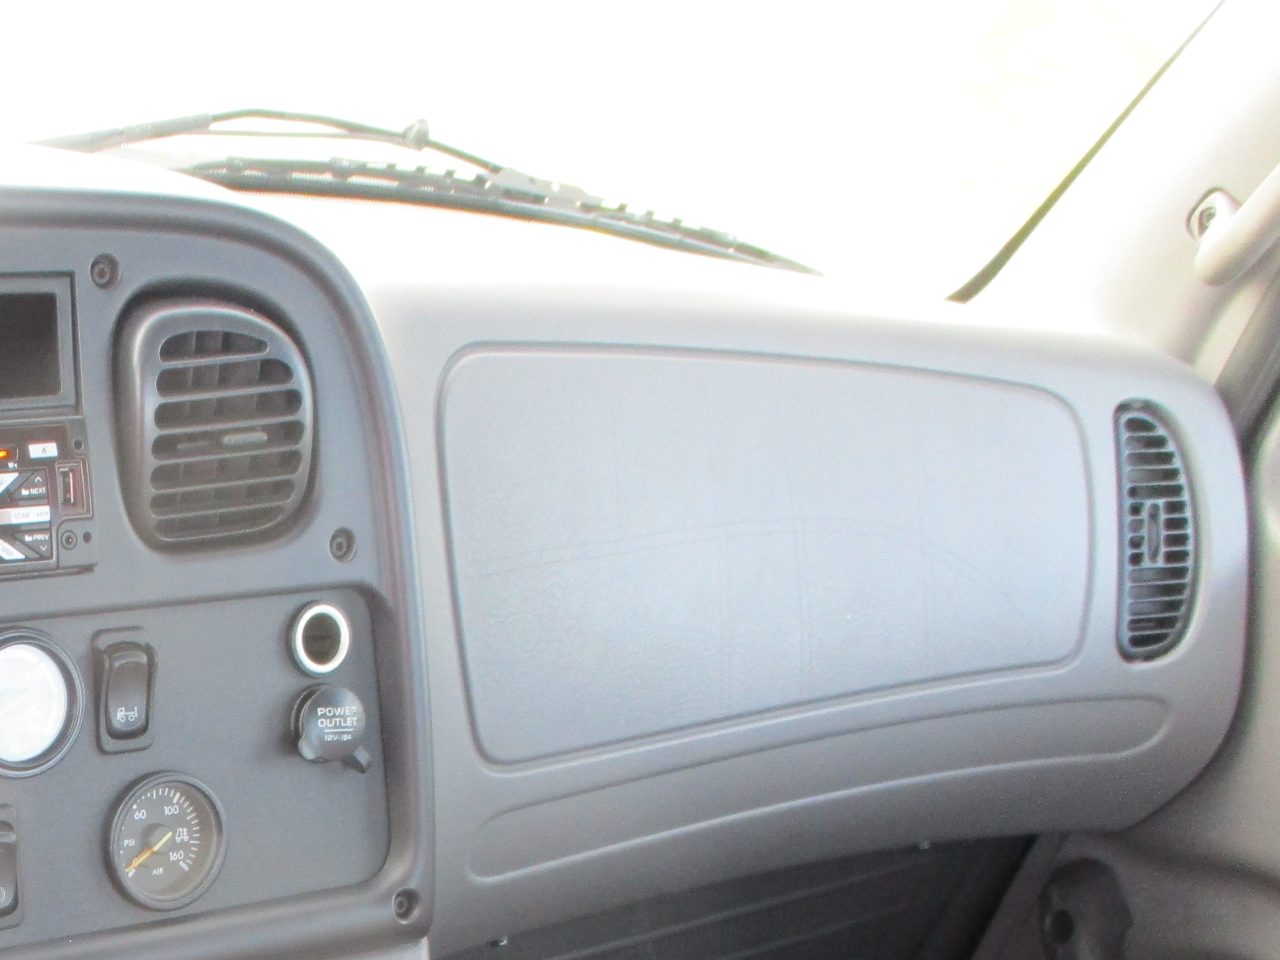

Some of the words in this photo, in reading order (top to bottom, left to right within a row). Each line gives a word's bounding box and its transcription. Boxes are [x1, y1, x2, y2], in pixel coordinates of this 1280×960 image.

[30, 487, 46, 495] NEXT
[317, 706, 357, 717] POWER
[318, 717, 358, 728] OUTLET
[134, 809, 147, 820] 60
[163, 805, 179, 816] 100
[123, 839, 135, 847] PSI
[169, 850, 184, 861] 160
[152, 867, 164, 876] AIR
